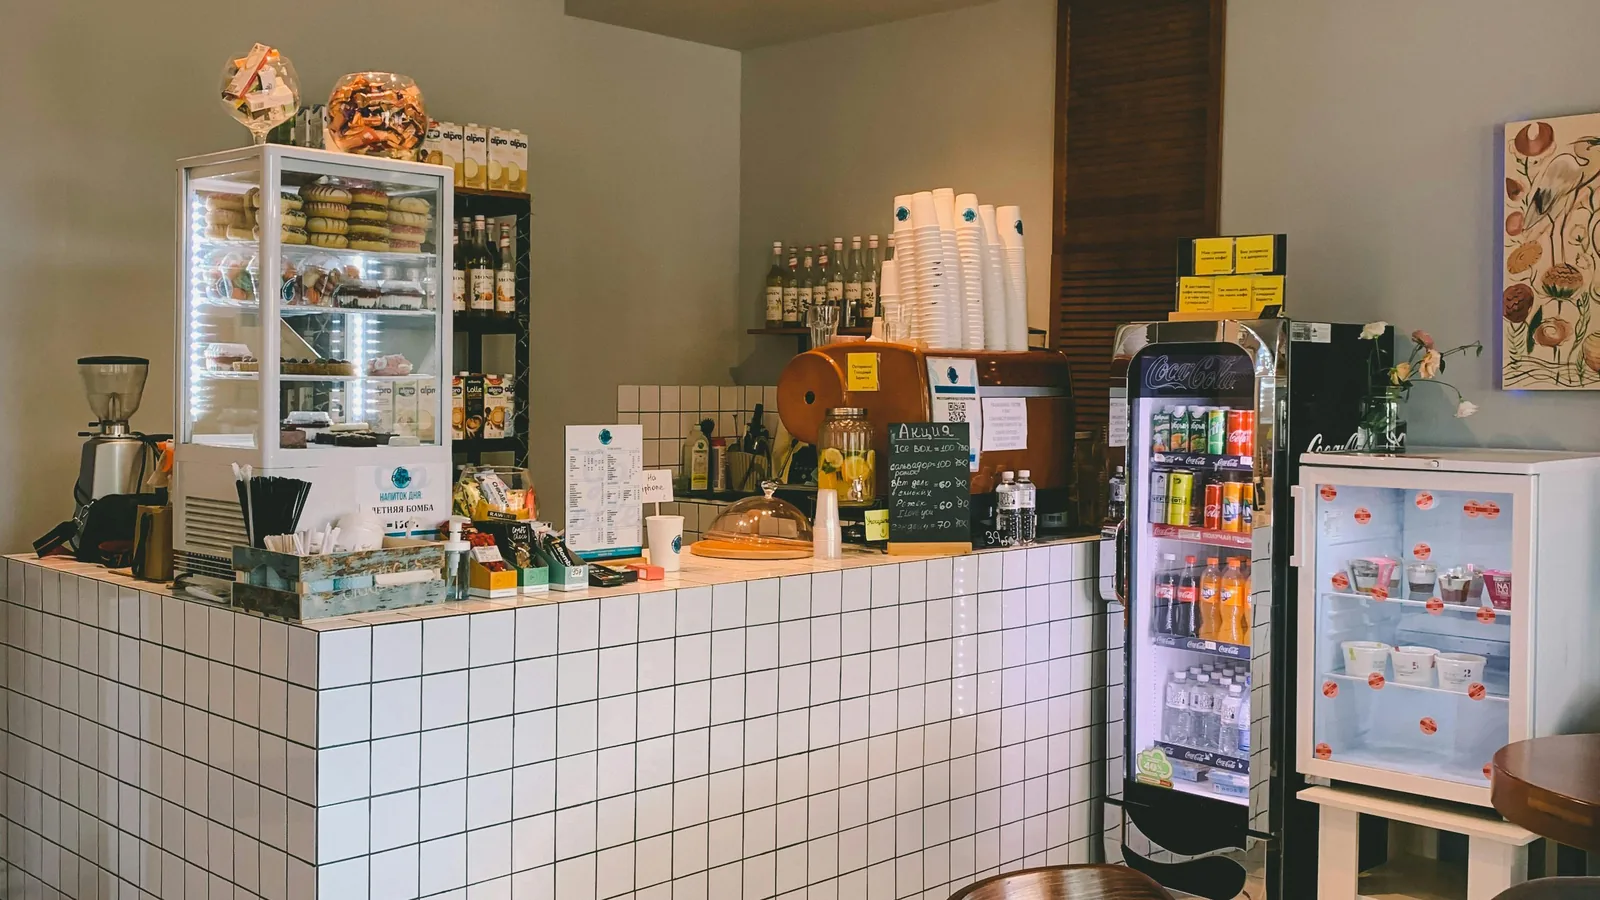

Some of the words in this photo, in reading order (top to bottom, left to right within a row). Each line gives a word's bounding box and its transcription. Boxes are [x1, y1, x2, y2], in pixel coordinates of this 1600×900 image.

[443, 132, 462, 141] alpro
[466, 134, 485, 144] alpro
[490, 136, 508, 146] alpro
[510, 139, 527, 149] alpro
[1145, 355, 1243, 390] Coca-Cola
[899, 423, 954, 439] Акция
[380, 492, 408, 501] НАПИТОК
[406, 504, 434, 512] БОМБА
[921, 510, 934, 519] you
[985, 531, 1000, 544] 39
[1218, 645, 1239, 655] Coca-Cola
[1216, 758, 1236, 769] Coca-Cola
